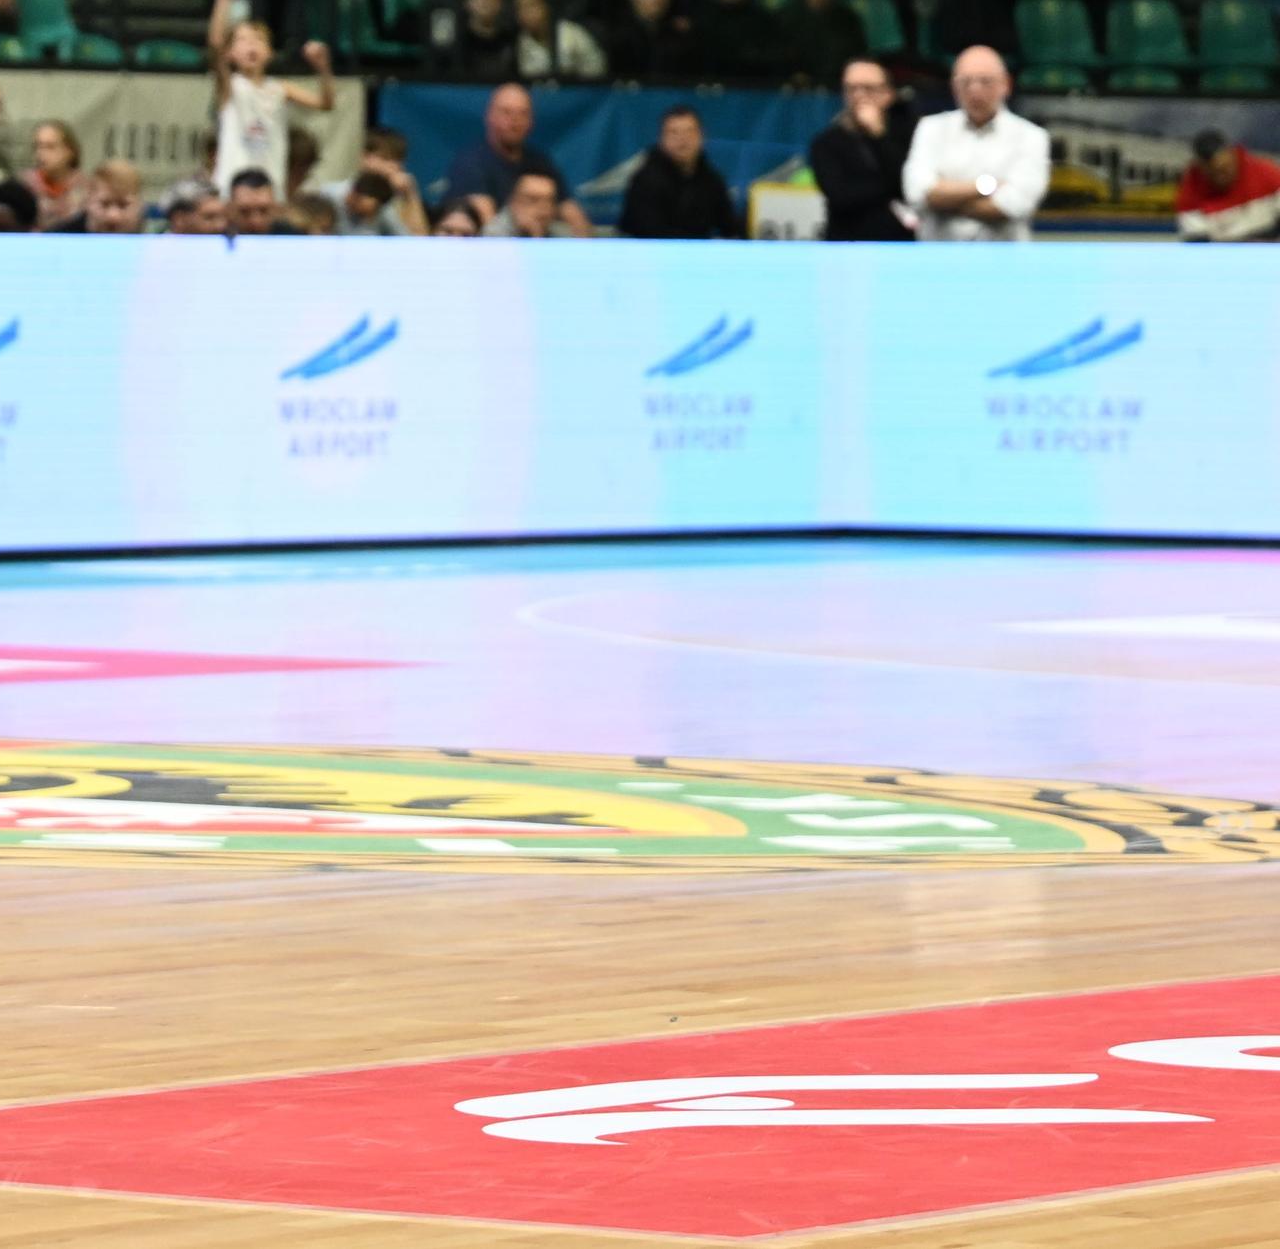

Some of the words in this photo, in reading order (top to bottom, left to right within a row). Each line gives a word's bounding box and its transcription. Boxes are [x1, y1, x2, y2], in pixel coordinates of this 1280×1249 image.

[278, 397, 398, 422] WROCLAW
[984, 396, 1144, 421] WROCLAW
[287, 432, 389, 458] AIRPORT
[651, 427, 748, 452] AIRPORT
[997, 430, 1131, 453] AIRPORT
